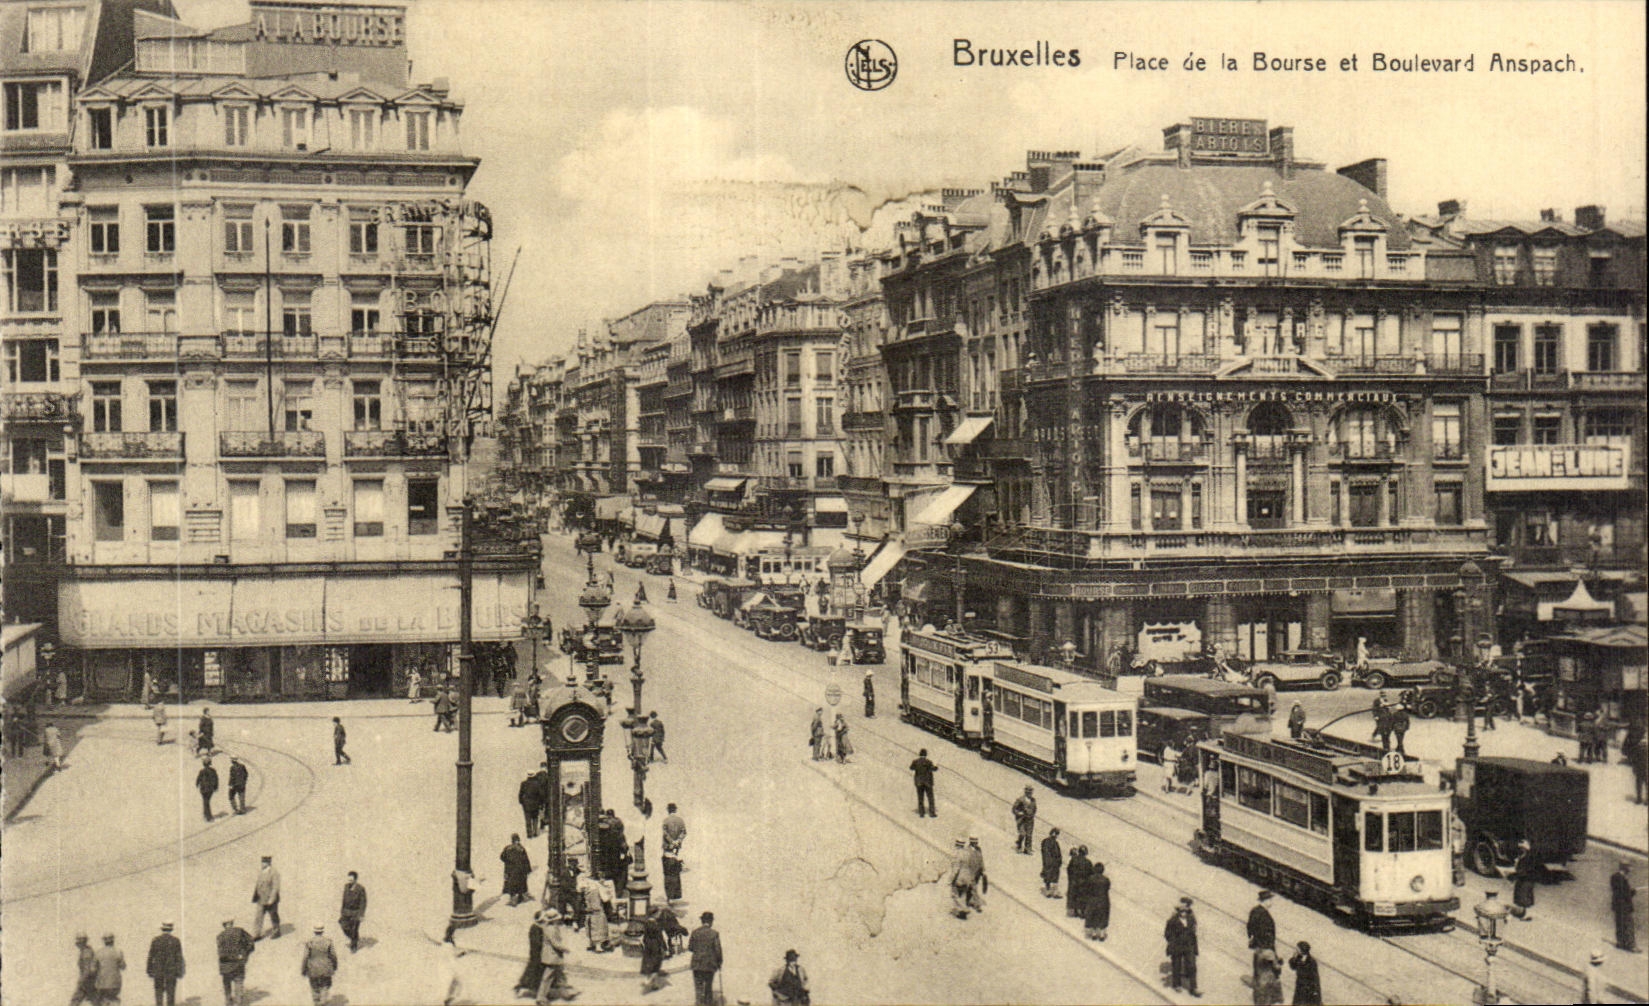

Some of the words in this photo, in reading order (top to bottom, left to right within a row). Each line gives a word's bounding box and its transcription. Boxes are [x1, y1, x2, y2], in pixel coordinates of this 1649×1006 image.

[312, 13, 404, 46] BOURSE
[1196, 135, 1262, 151] ARTOIS
[1146, 391, 1287, 402] RENSEIGNEMENTS
[1295, 391, 1397, 402] COMMERCIAUX
[76, 611, 178, 636] GRANDS
[198, 610, 344, 635] MAGASINS
[398, 616, 426, 631] LA
[436, 605, 522, 631] BURS
[987, 642, 999, 655] 53
[1385, 753, 1401, 773] 18
